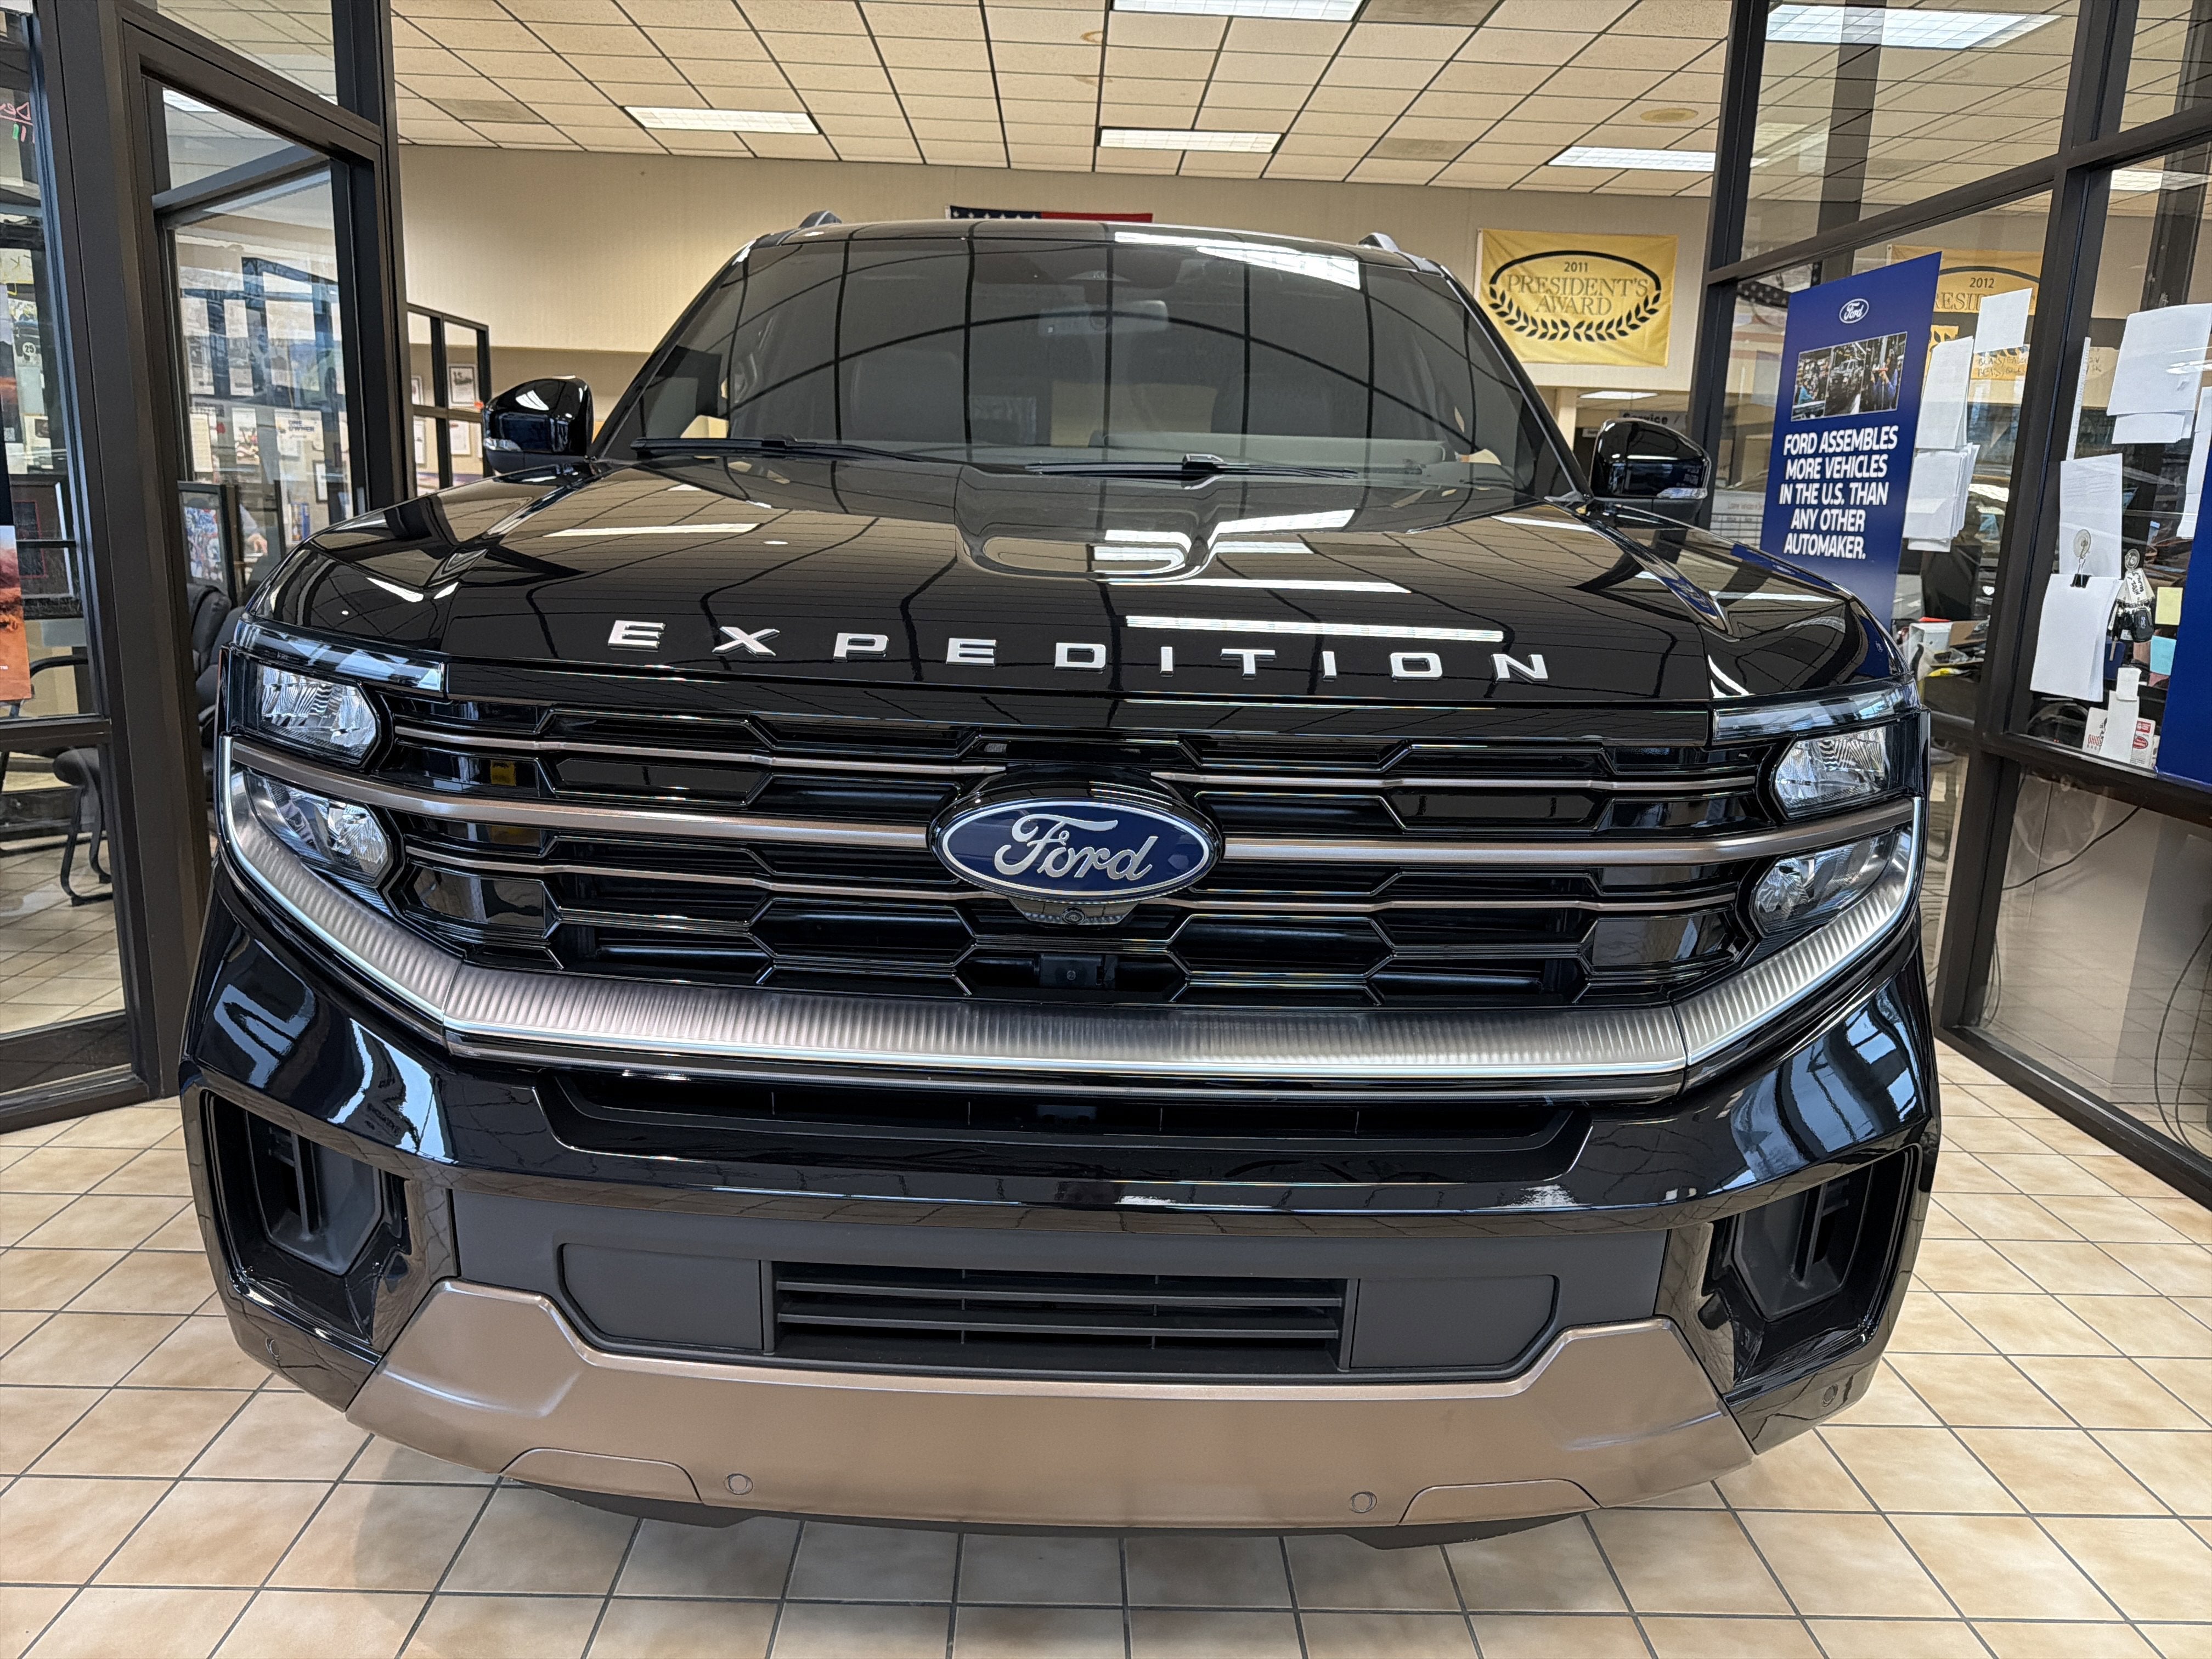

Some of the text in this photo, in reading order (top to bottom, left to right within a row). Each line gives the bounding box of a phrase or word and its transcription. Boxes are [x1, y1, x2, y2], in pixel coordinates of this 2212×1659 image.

[1564, 262, 1588, 273] 2011
[1506, 275, 1648, 296] PRESIDENT'S
[1970, 277, 1995, 289] 2012
[1534, 296, 1612, 315] AWARD
[1843, 302, 1864, 320] Ford
[24, 345, 35, 353] 25
[1783, 425, 1899, 456] FORD ASSEMBLES
[1785, 454, 1888, 480] MORE VEHICLES
[1779, 482, 1889, 505] IN THE U.S. THAN
[1790, 508, 1866, 532] ANY OTHER
[1783, 533, 1866, 560] AUTOMAKER.
[607, 619, 1549, 682] EXPEDITION
[994, 814, 1159, 881] Ford
